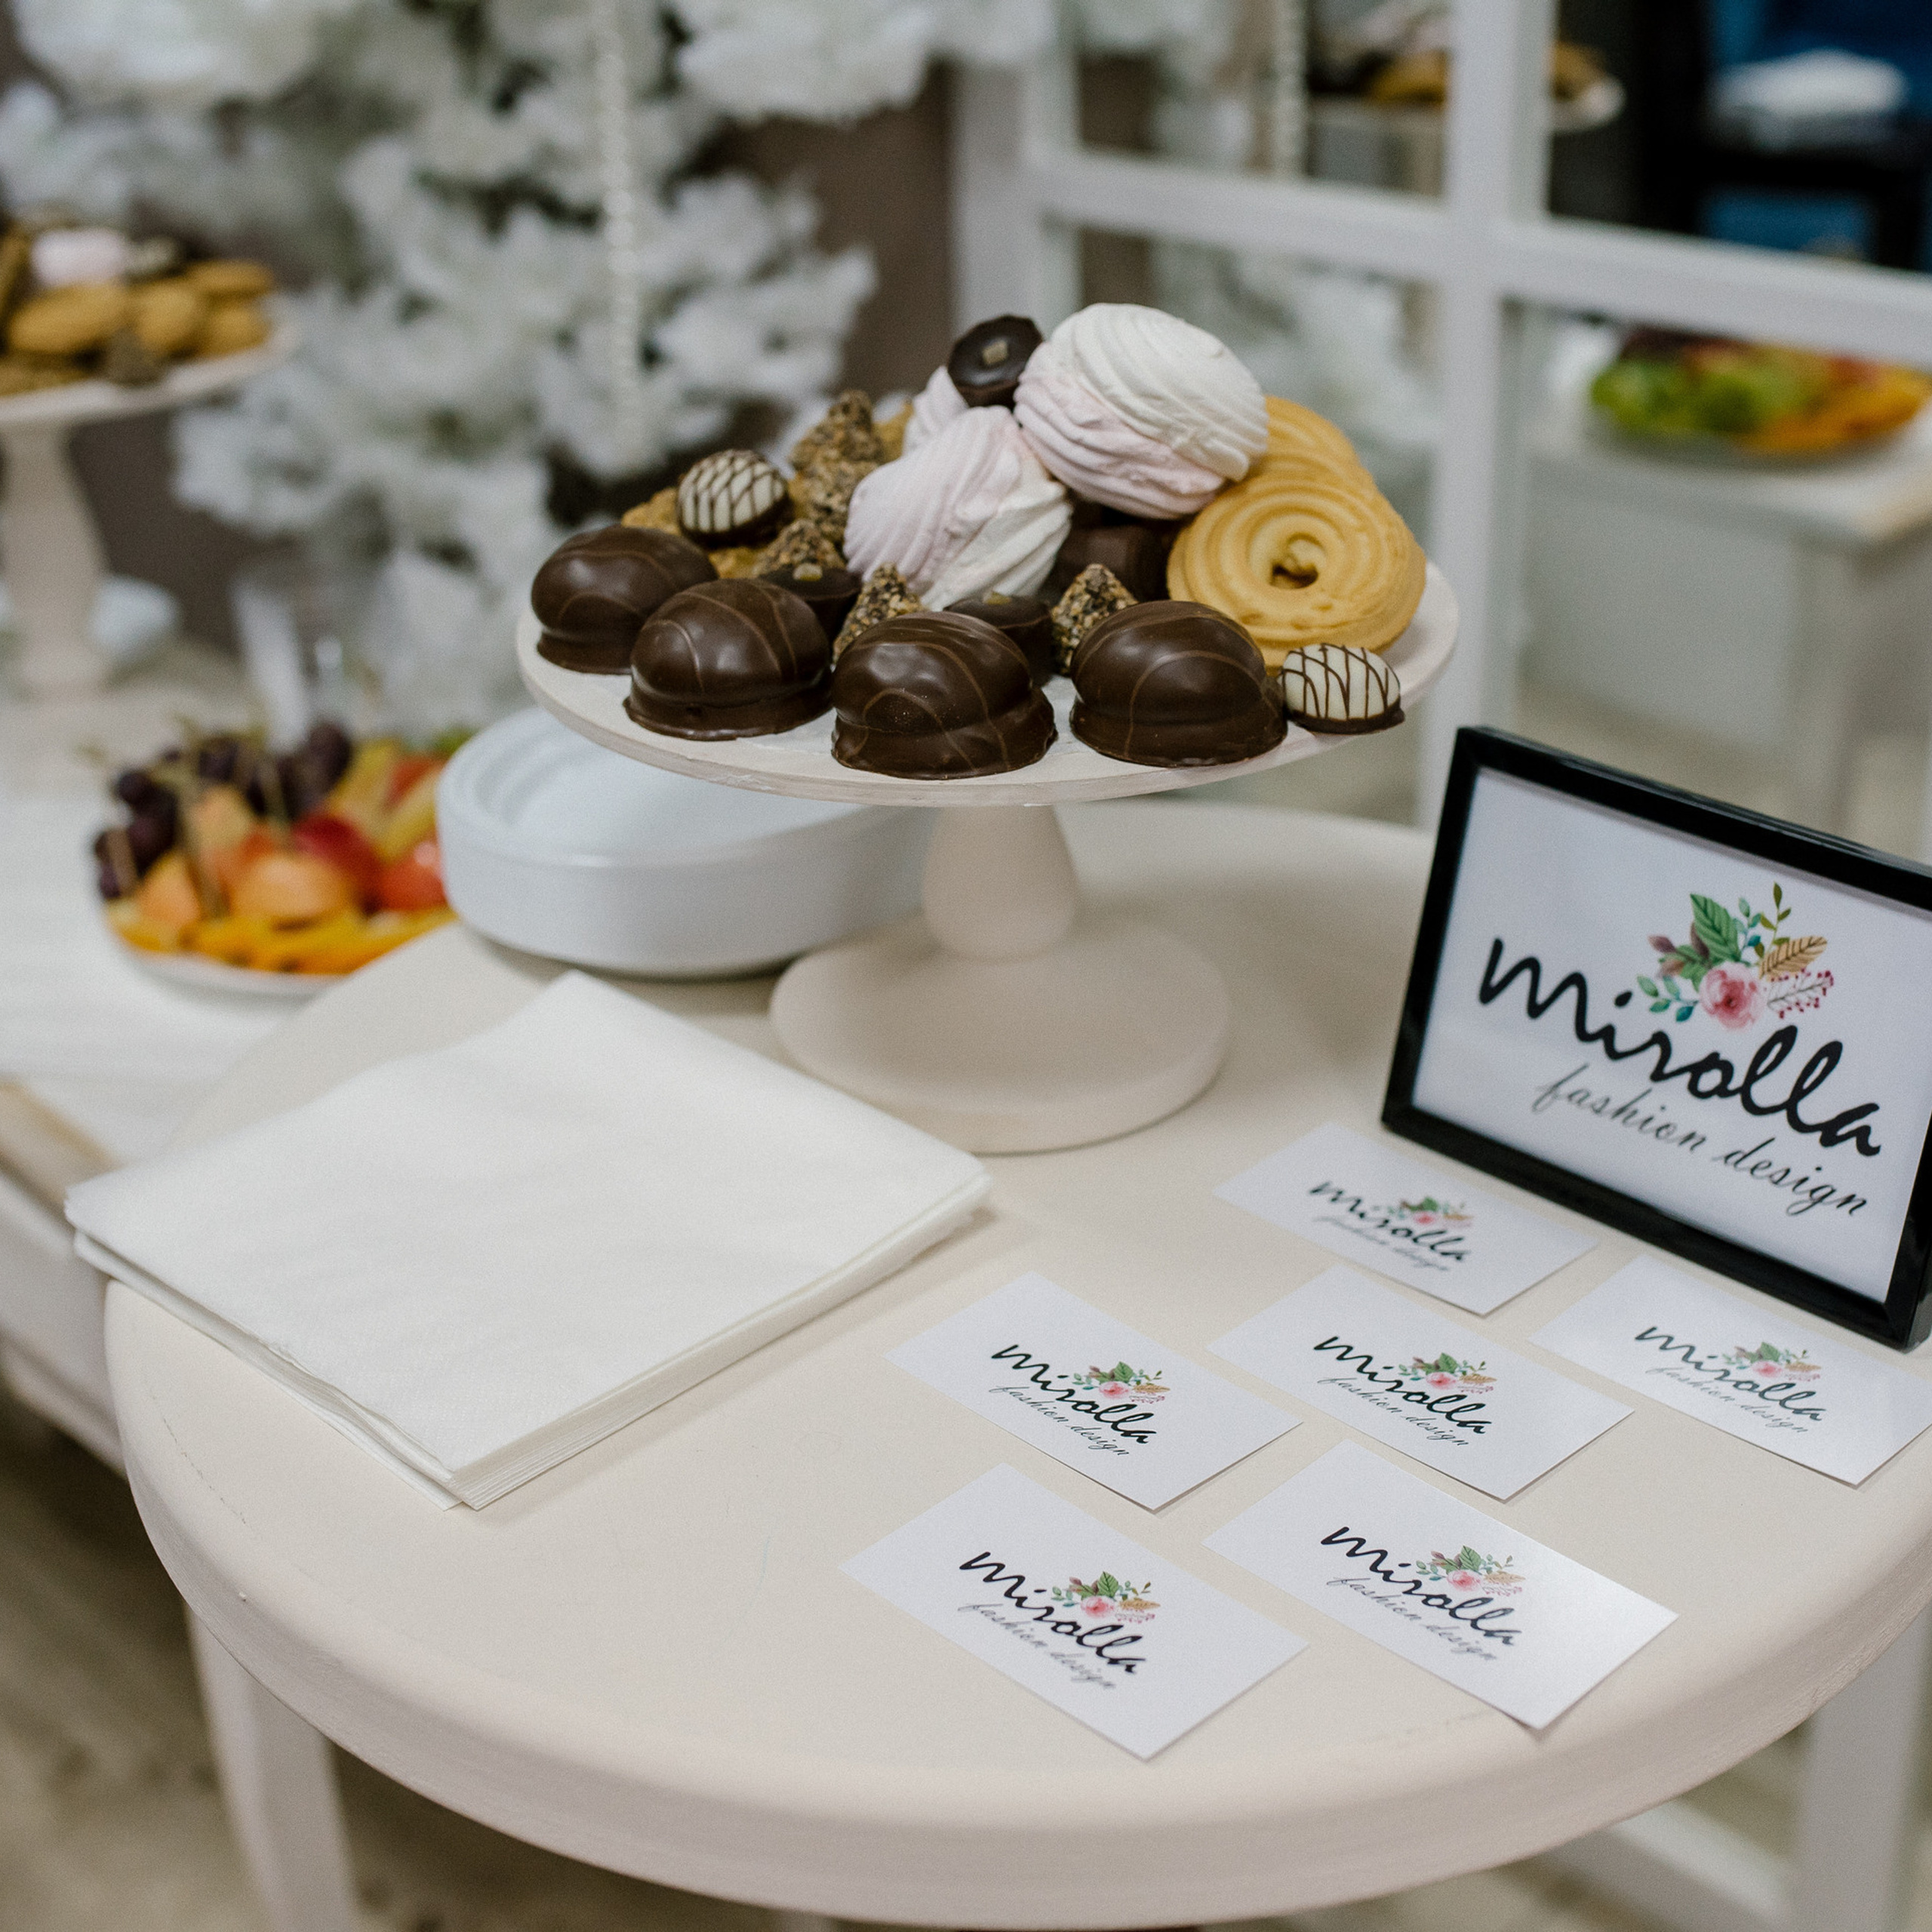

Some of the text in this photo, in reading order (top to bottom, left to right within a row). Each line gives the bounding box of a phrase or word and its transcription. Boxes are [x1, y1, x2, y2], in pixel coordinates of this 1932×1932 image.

[1479, 938, 1881, 1156] mirolla
[1531, 1063, 1868, 1216] fashion design
[989, 1386, 1130, 1456] fashion design
[991, 1344, 1157, 1444] mirolla
[1313, 1336, 1493, 1434] mirolla
[1317, 1377, 1469, 1445] fashion design
[1635, 1326, 1826, 1421] mirolla
[959, 1552, 1146, 1675] mirolla
[1321, 1527, 1521, 1646] mirolla
